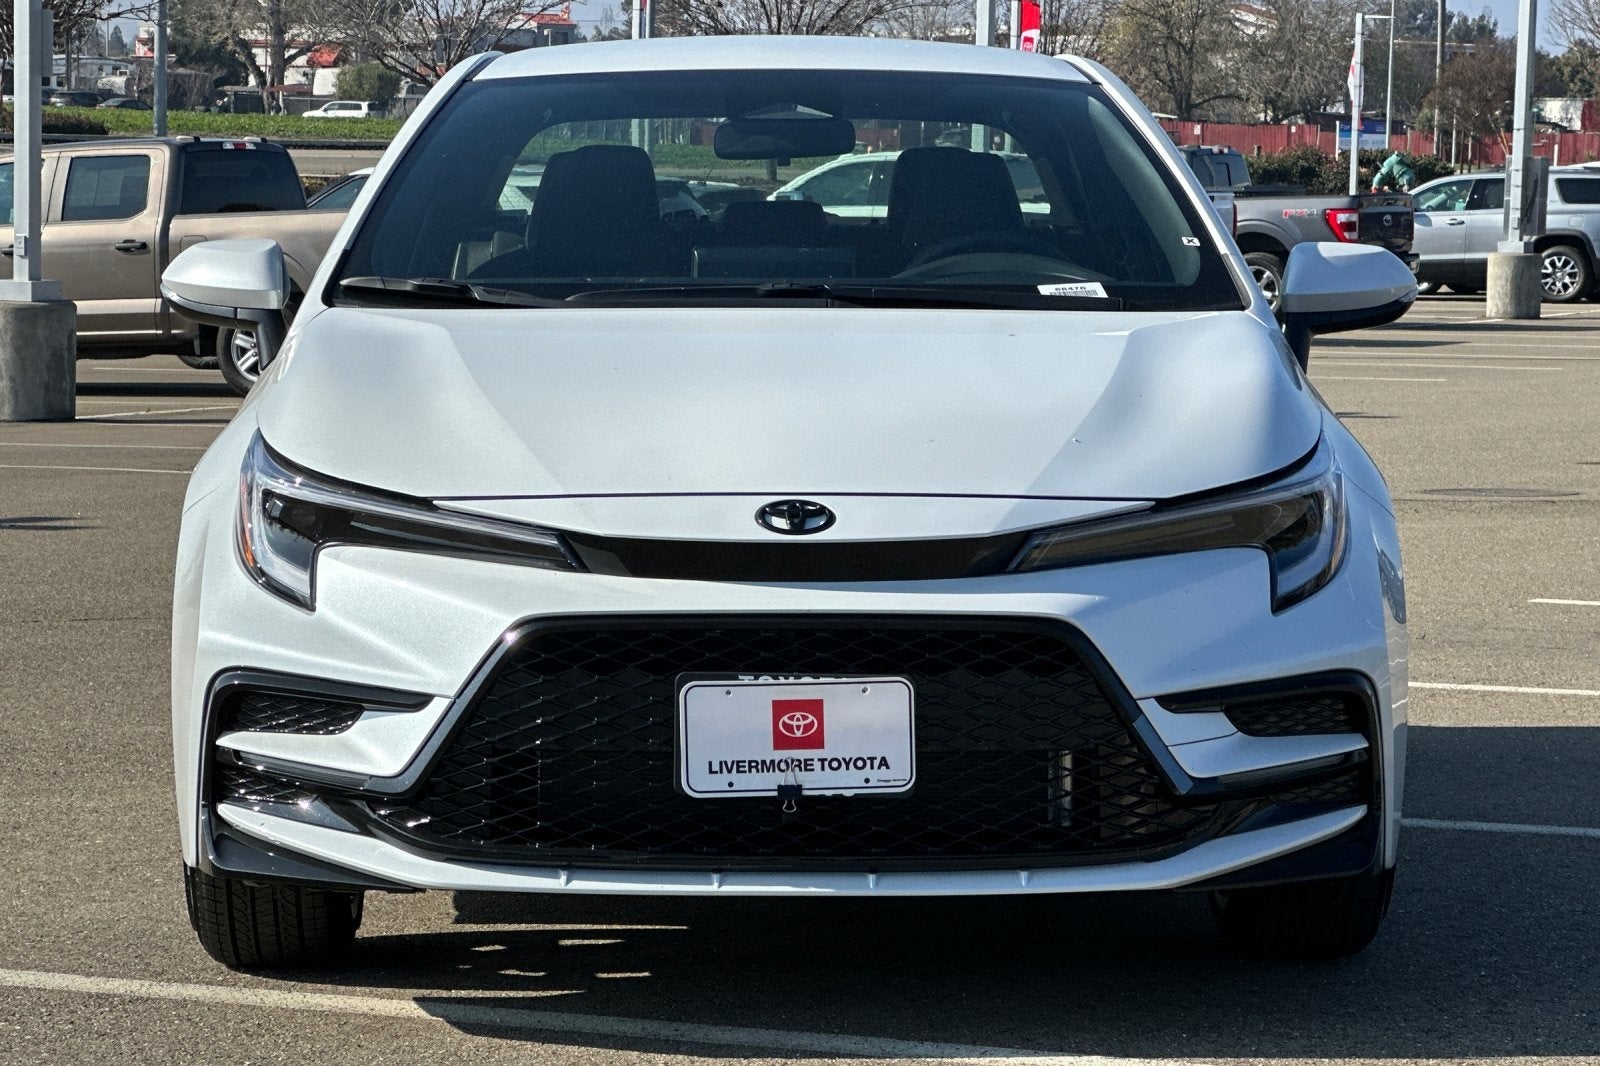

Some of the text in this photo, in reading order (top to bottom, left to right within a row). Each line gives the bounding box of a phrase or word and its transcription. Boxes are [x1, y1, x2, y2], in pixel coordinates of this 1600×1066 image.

[1282, 208, 1318, 219] FX4
[708, 756, 890, 775] LIVERMORE TOYOTA
